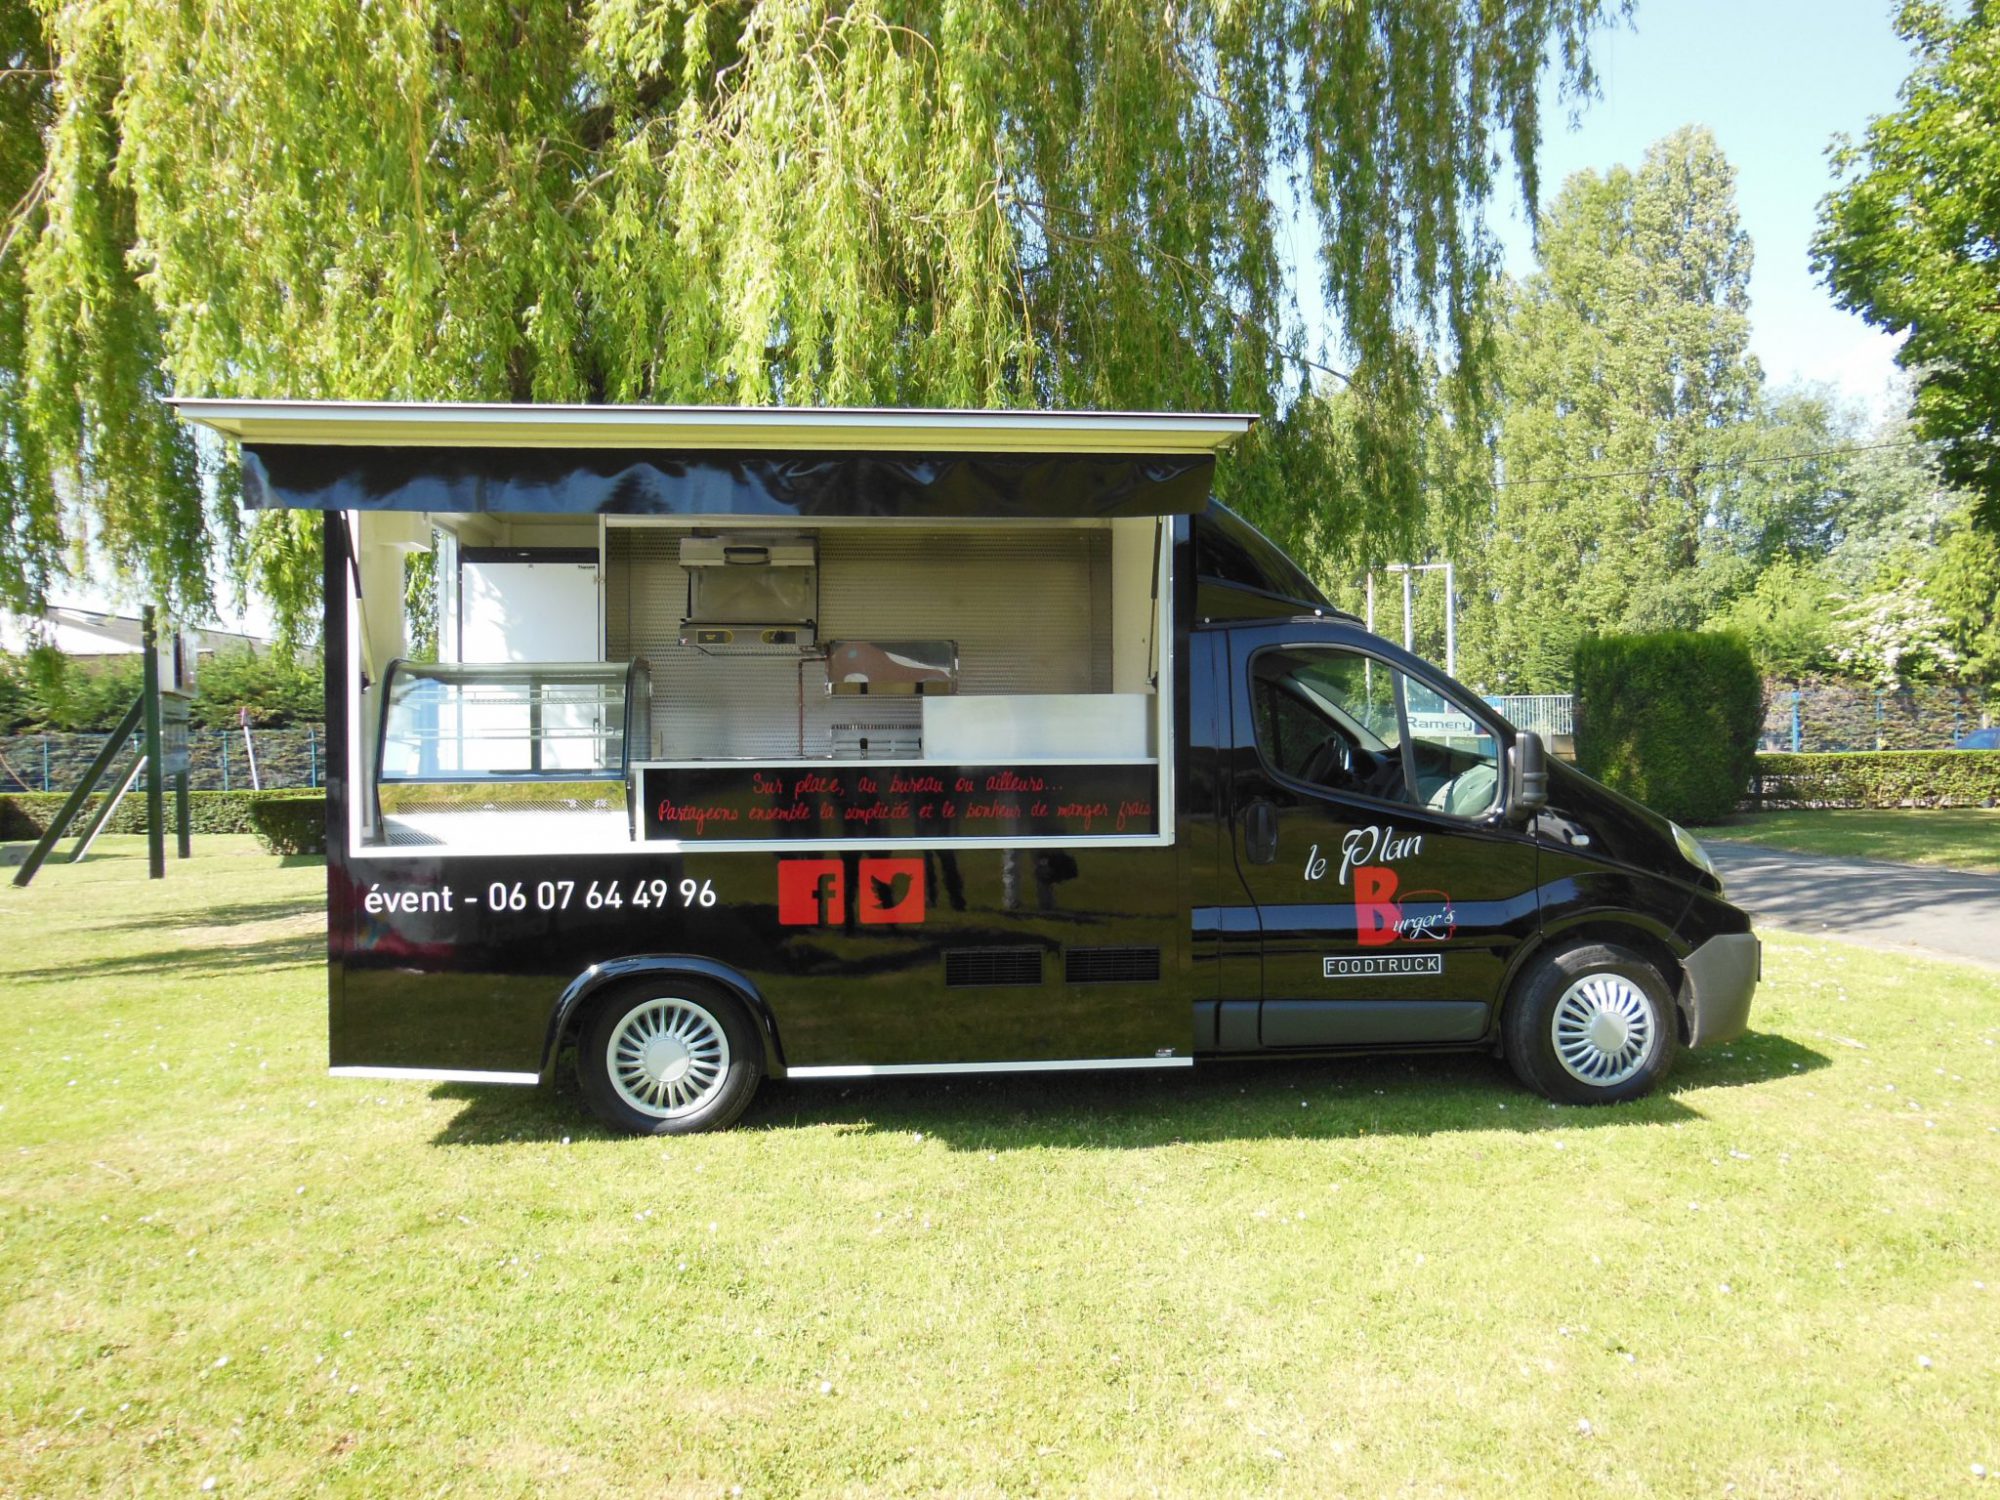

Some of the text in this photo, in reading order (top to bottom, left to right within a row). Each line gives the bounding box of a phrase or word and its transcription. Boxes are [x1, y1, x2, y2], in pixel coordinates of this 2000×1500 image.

[1407, 716, 1473, 732] Ramery
[753, 773, 783, 794] Sur
[795, 773, 844, 799] place,
[858, 776, 877, 792] au
[890, 774, 943, 793] bureau
[955, 776, 974, 792] ou
[658, 799, 738, 835] Partageons
[749, 803, 809, 821] ensemble
[820, 803, 834, 819] la
[844, 802, 910, 824] simplicité
[919, 802, 934, 819] et
[943, 800, 956, 818] le
[966, 800, 1021, 819] bonheur
[1031, 800, 1048, 818] de
[1058, 802, 1108, 831] manger
[1304, 825, 1422, 886] le Plan
[365, 883, 453, 914] évent
[488, 881, 527, 911] 06
[537, 880, 575, 910] 07
[586, 880, 623, 909] 64
[632, 879, 668, 908] 49
[679, 878, 717, 908] 96
[1327, 957, 1438, 974] FOODTRUCK
